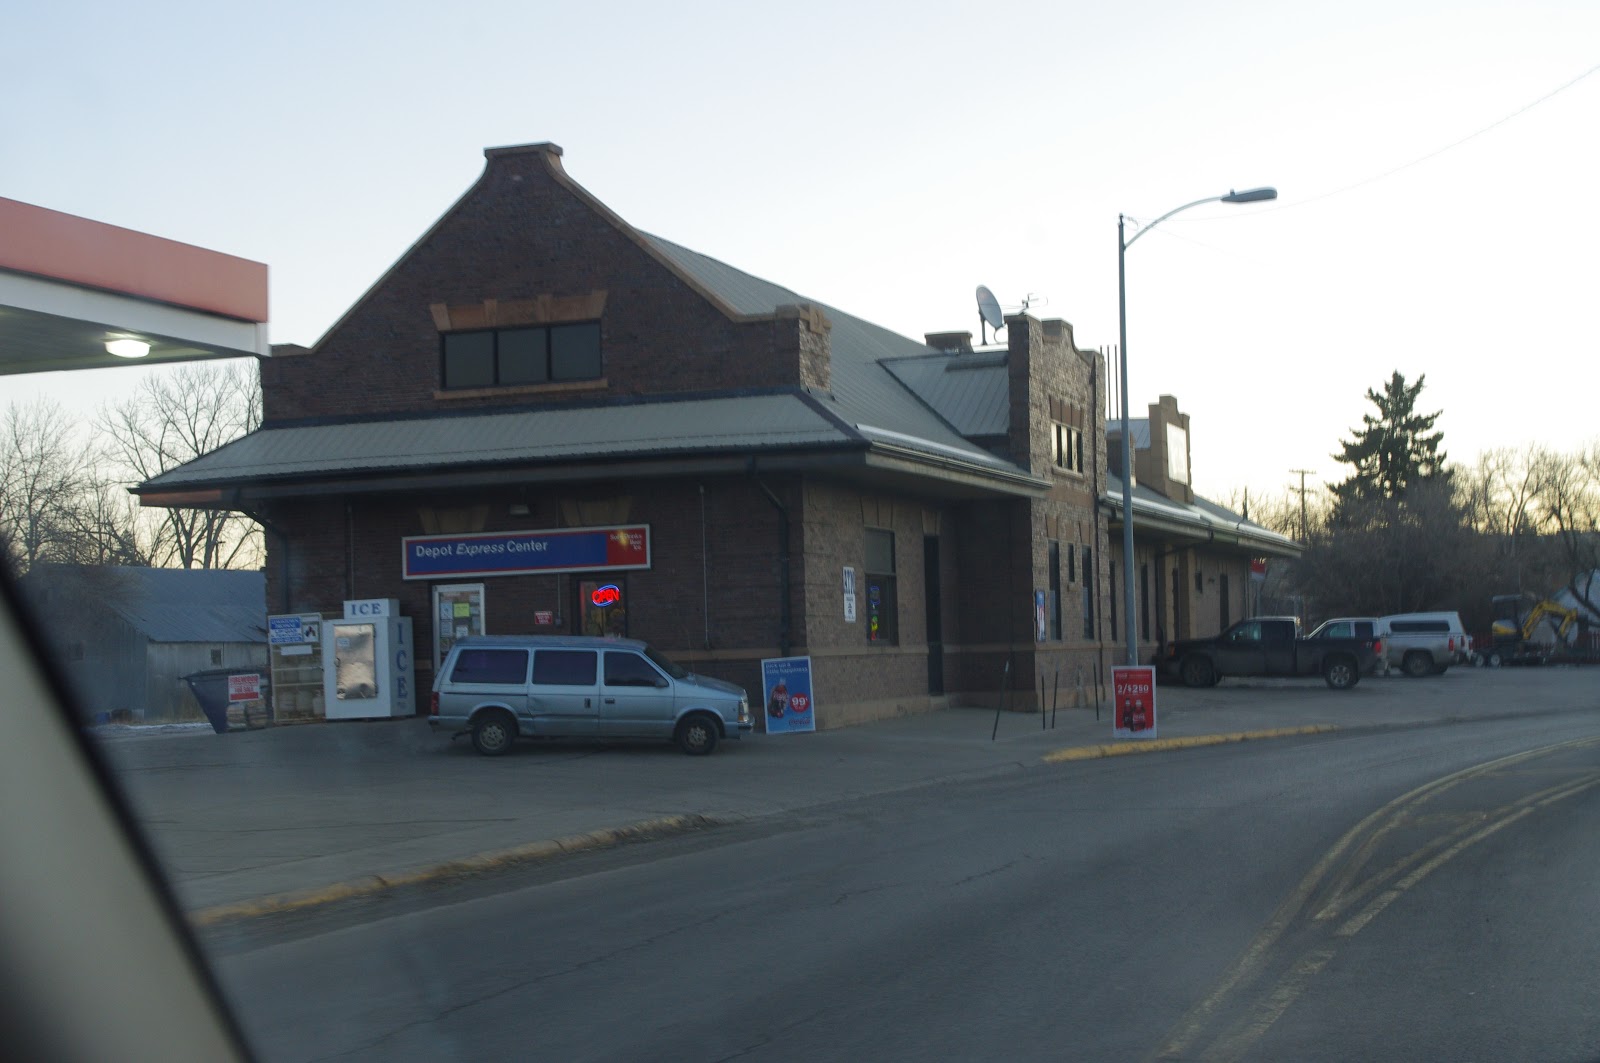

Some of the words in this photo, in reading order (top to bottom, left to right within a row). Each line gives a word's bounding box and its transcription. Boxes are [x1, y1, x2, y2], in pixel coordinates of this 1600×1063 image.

[416, 544, 453, 559] Depot
[456, 542, 505, 557] Express
[507, 540, 548, 554] Center
[592, 589, 620, 603] OPEN
[351, 603, 381, 615] ICE
[396, 622, 408, 699] ICE
